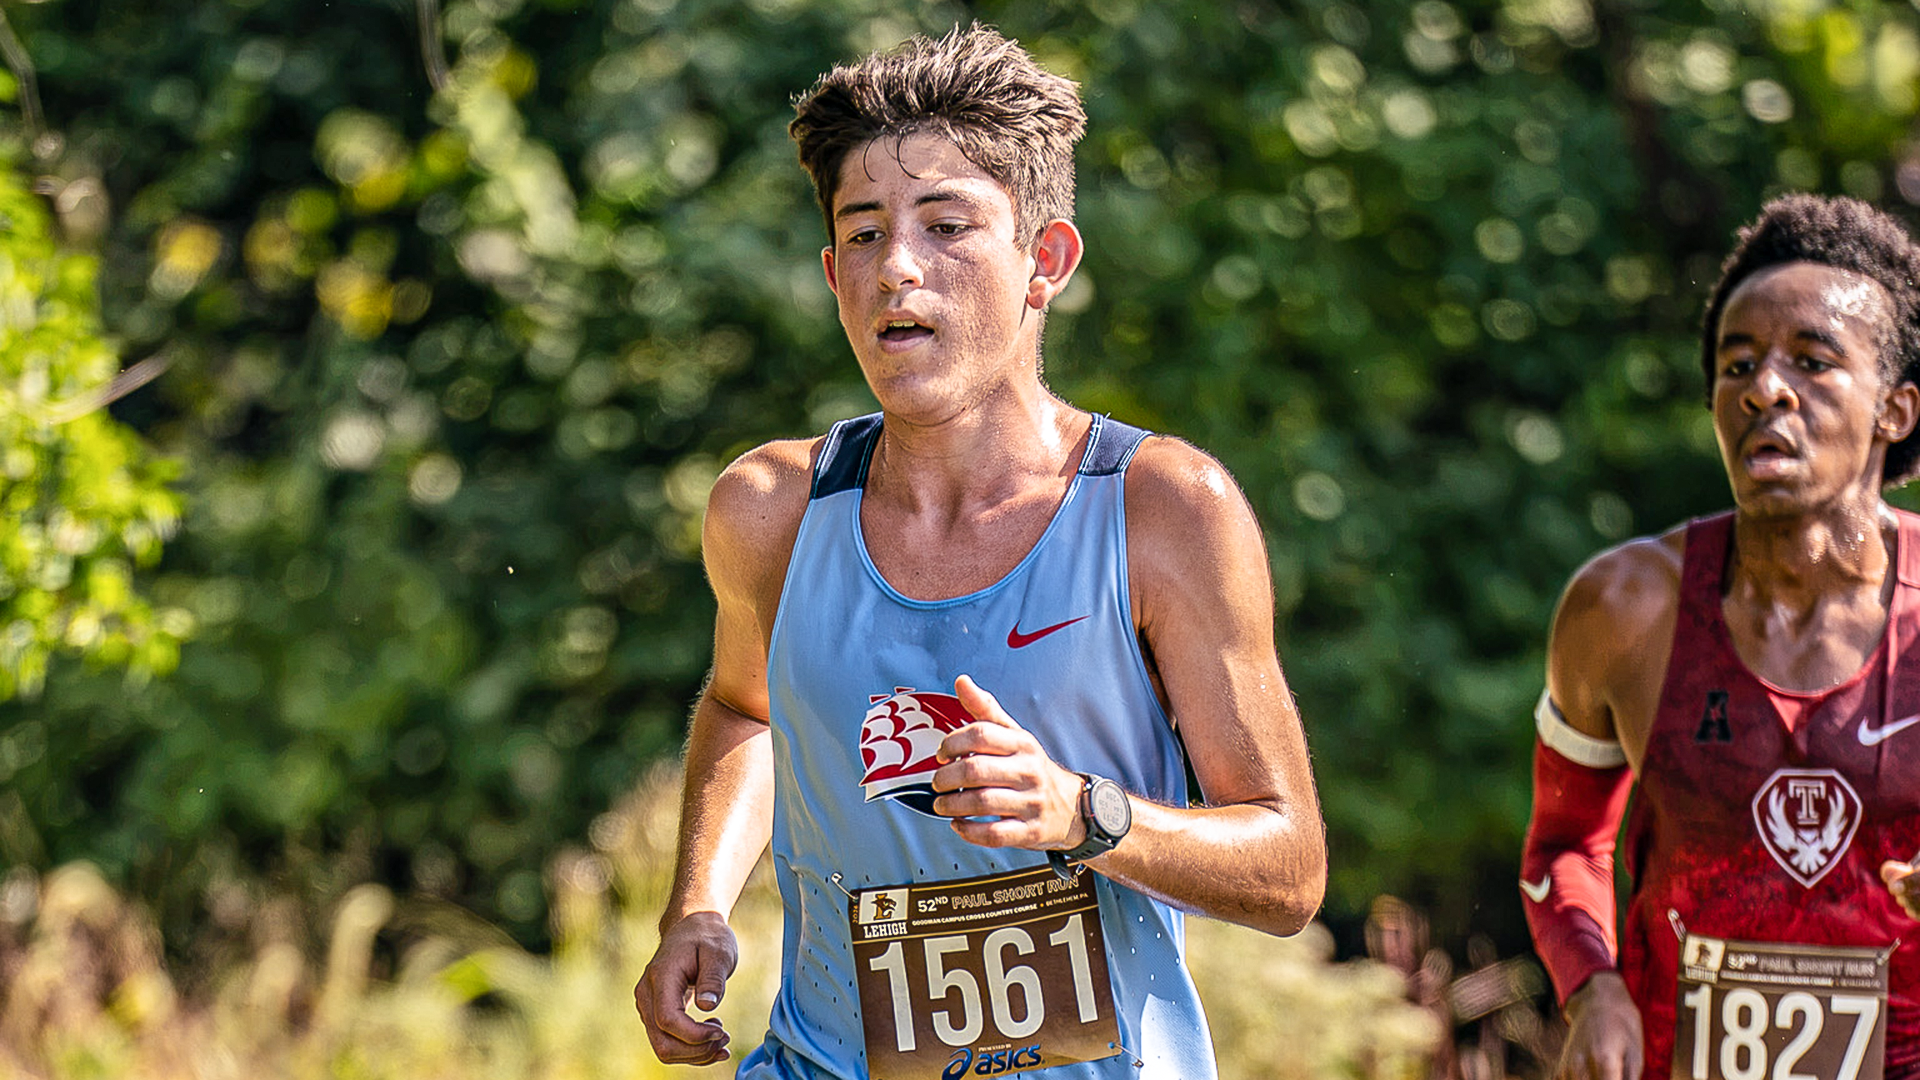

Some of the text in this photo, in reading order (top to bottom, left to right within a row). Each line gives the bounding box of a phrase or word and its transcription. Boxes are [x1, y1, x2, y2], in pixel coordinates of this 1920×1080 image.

[1788, 779, 1827, 825] T
[917, 875, 1079, 912] 52ND PAUL SHORT RUN
[863, 922, 908, 938] LEHIGH
[912, 918, 941, 926] GOODMAN
[941, 915, 965, 923] CAMPUS
[966, 912, 986, 921] CROSS
[986, 908, 1013, 917] COUNTRY
[1014, 903, 1038, 913] COURSE
[869, 913, 1099, 1052] 1561
[1844, 960, 1876, 978] RUN
[1684, 984, 1880, 1080] 1827
